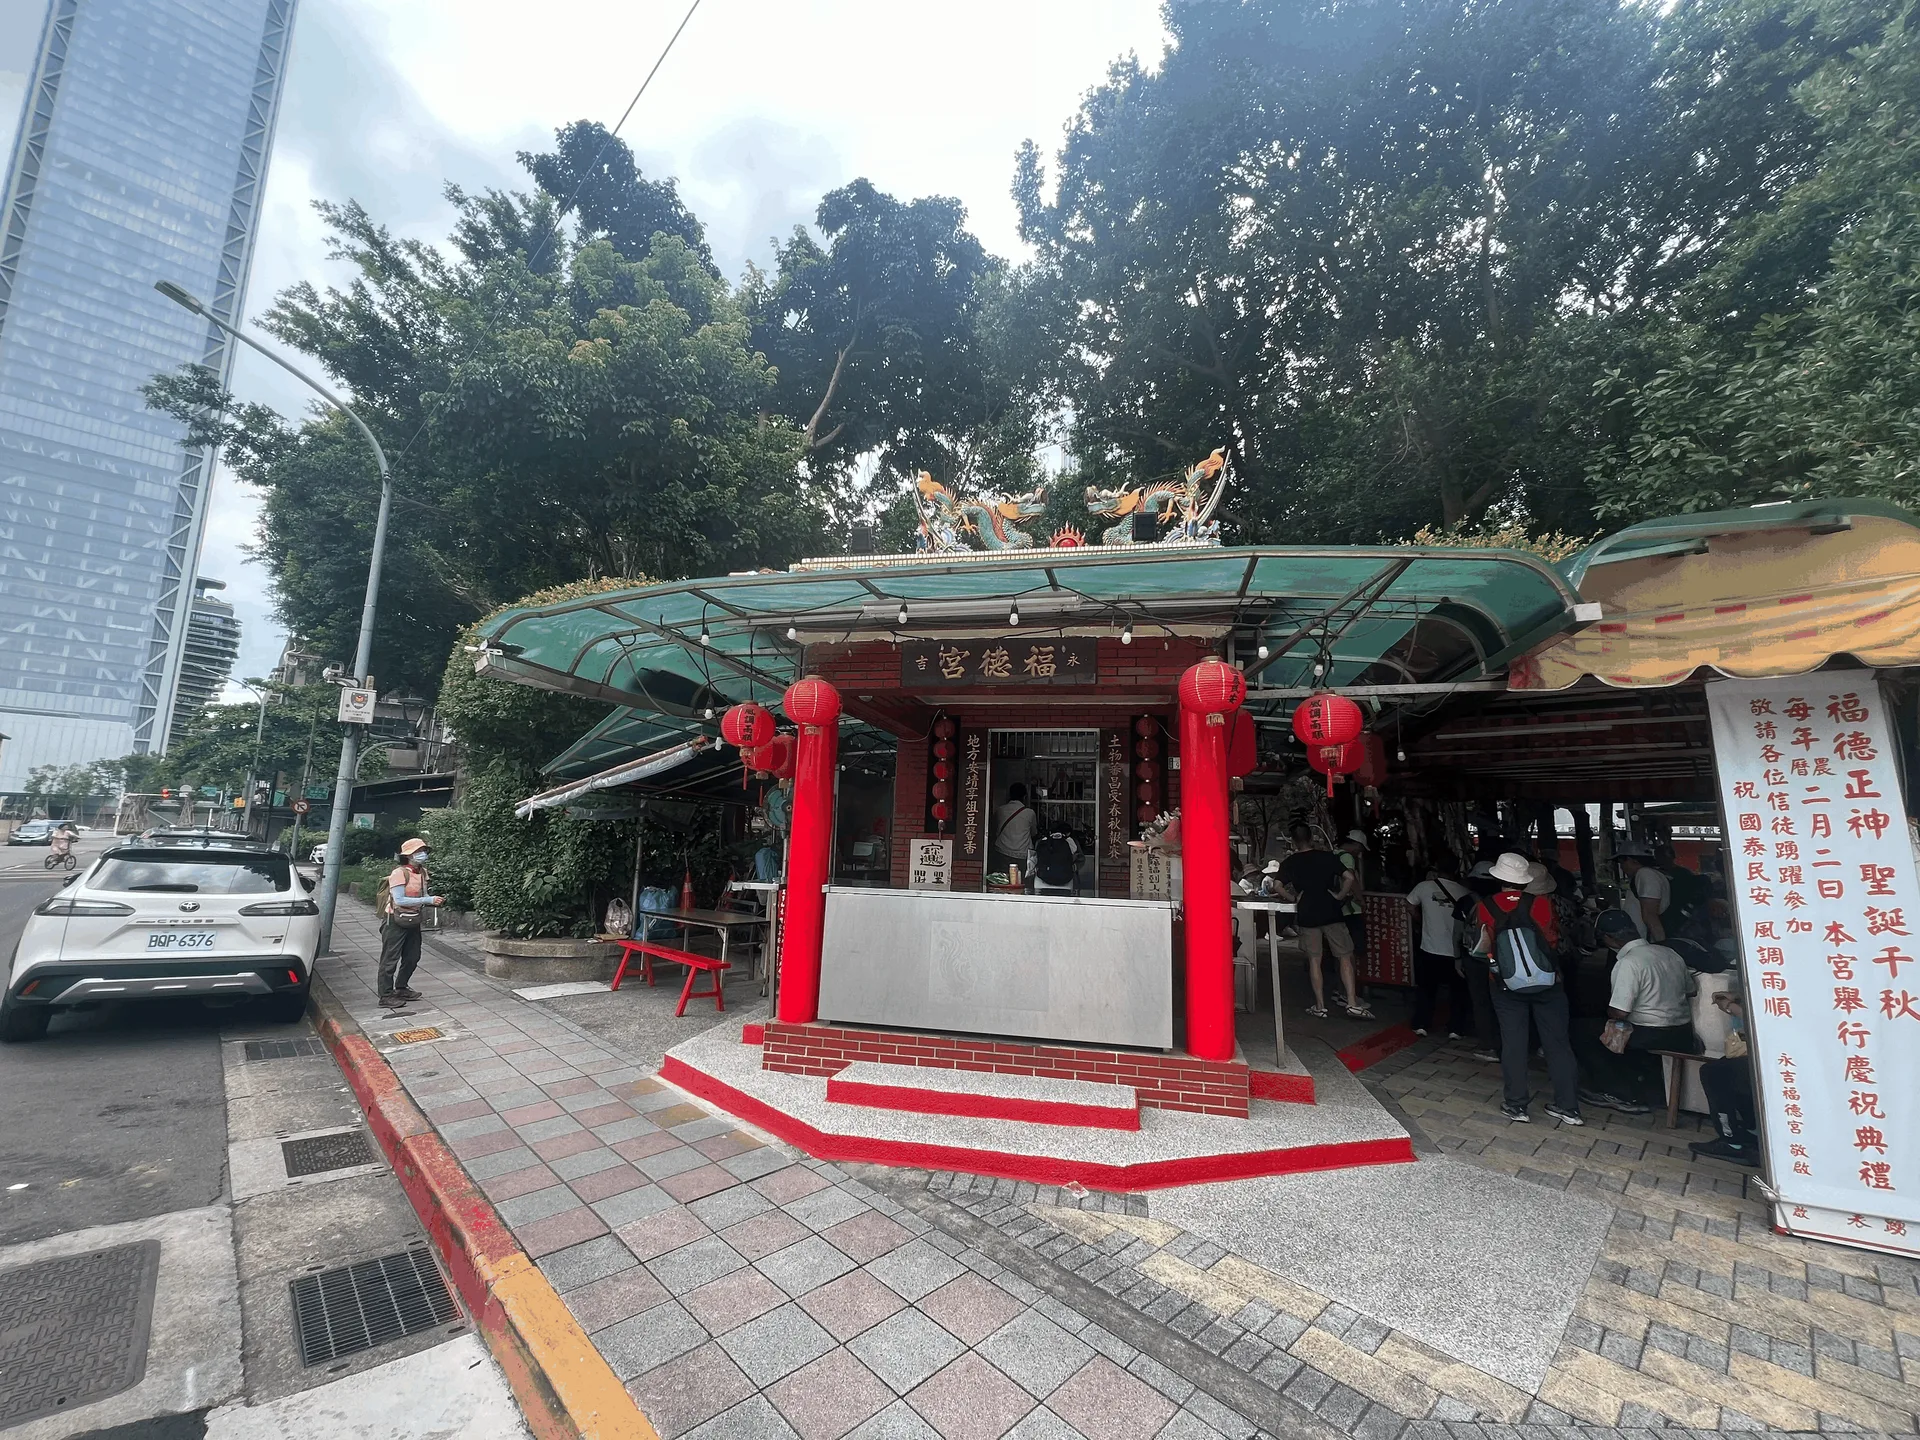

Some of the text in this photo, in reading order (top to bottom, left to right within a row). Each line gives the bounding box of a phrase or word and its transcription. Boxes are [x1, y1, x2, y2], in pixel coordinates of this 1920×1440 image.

[1733, 781, 1792, 1018] 祝 國泰民安 風調雨順
[1750, 699, 1813, 934] 敬請各位信徒踴躍參加
[1826, 693, 1920, 1021] 福德正神 聖誕千秋
[1778, 1053, 1803, 1134] 永吉福德宮
[1823, 921, 1896, 1191] 本宮舉行慶祝典禮
